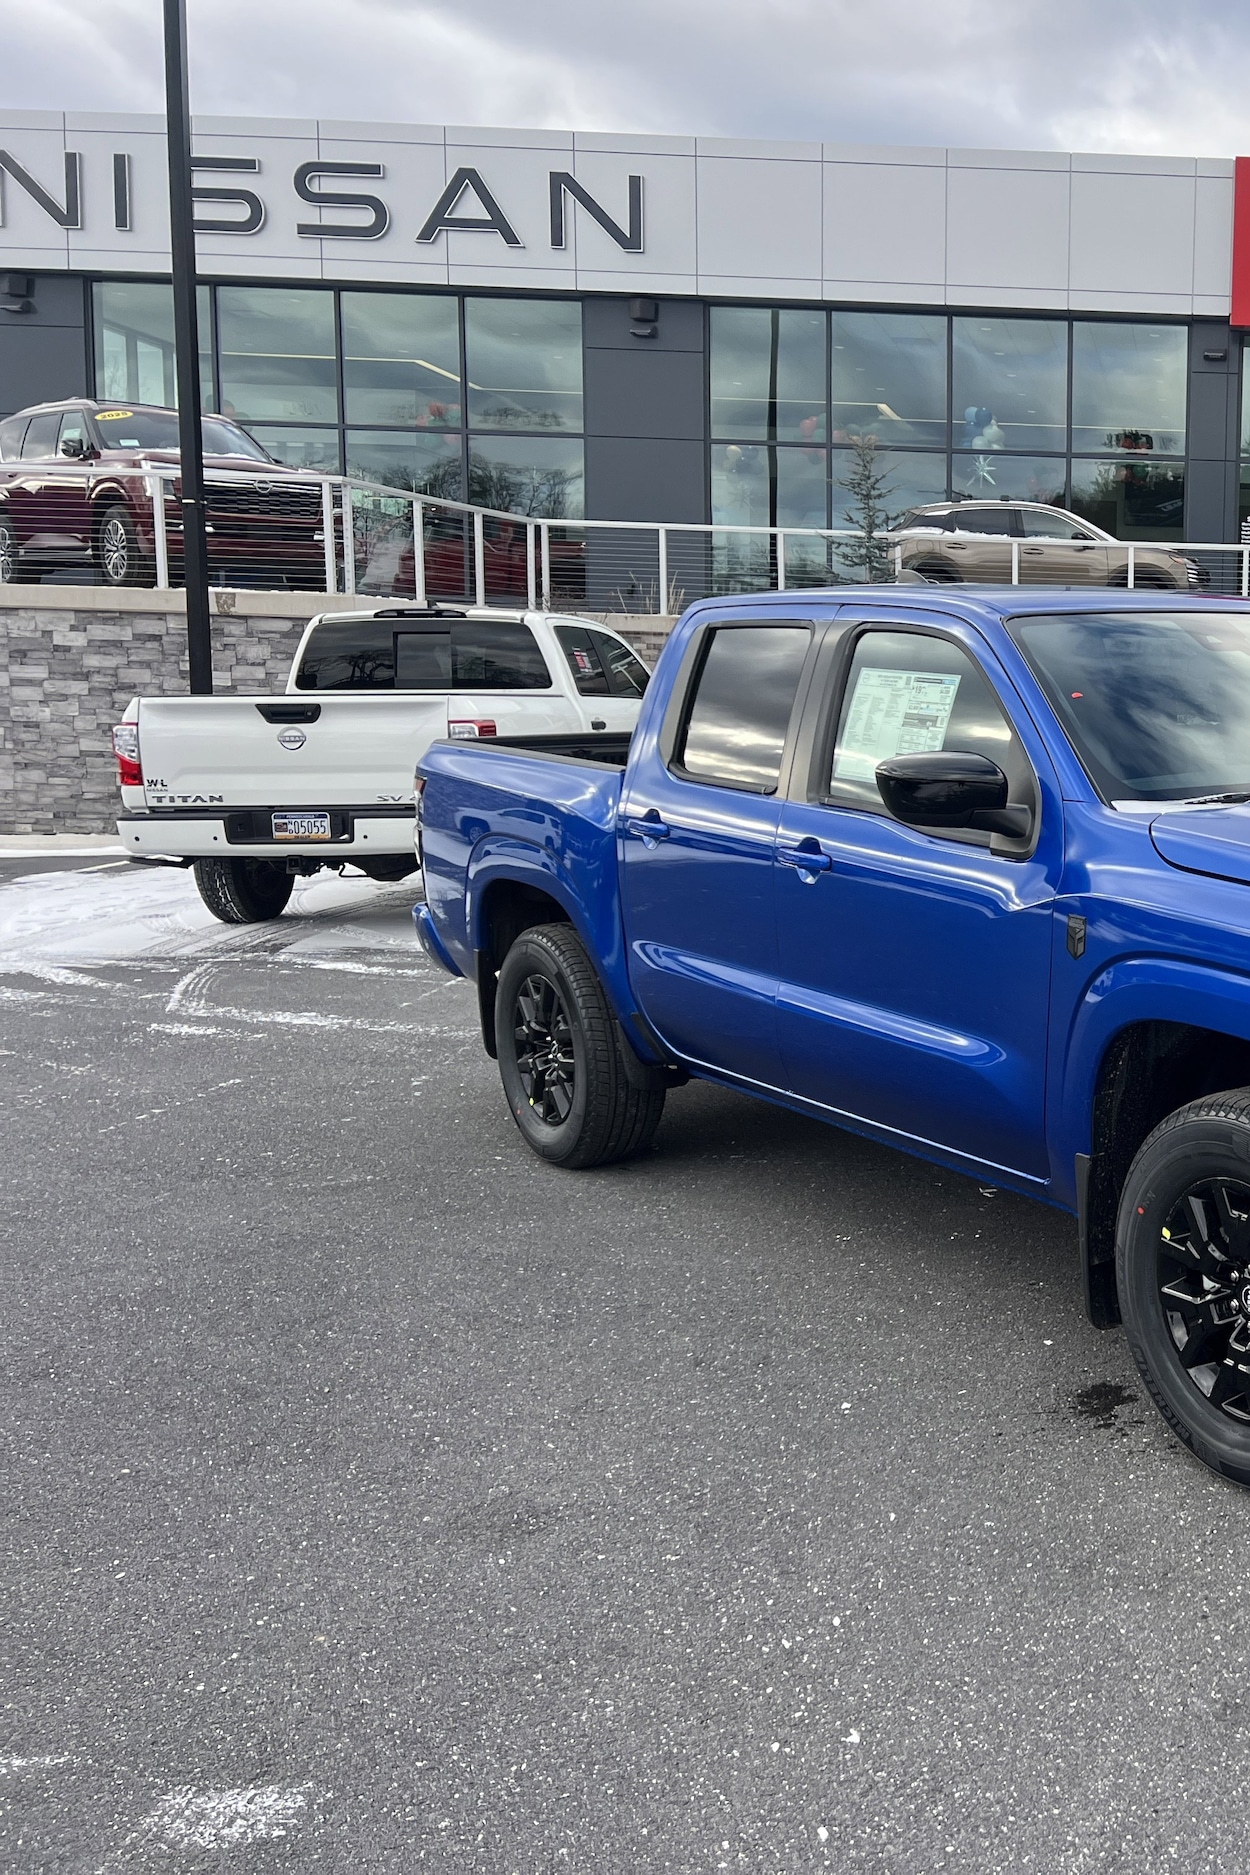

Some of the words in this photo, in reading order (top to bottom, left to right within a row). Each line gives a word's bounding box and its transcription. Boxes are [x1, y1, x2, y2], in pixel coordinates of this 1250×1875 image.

[0, 149, 644, 253] NISSAN
[152, 795, 224, 803] TITAN
[294, 820, 327, 835] 05055
